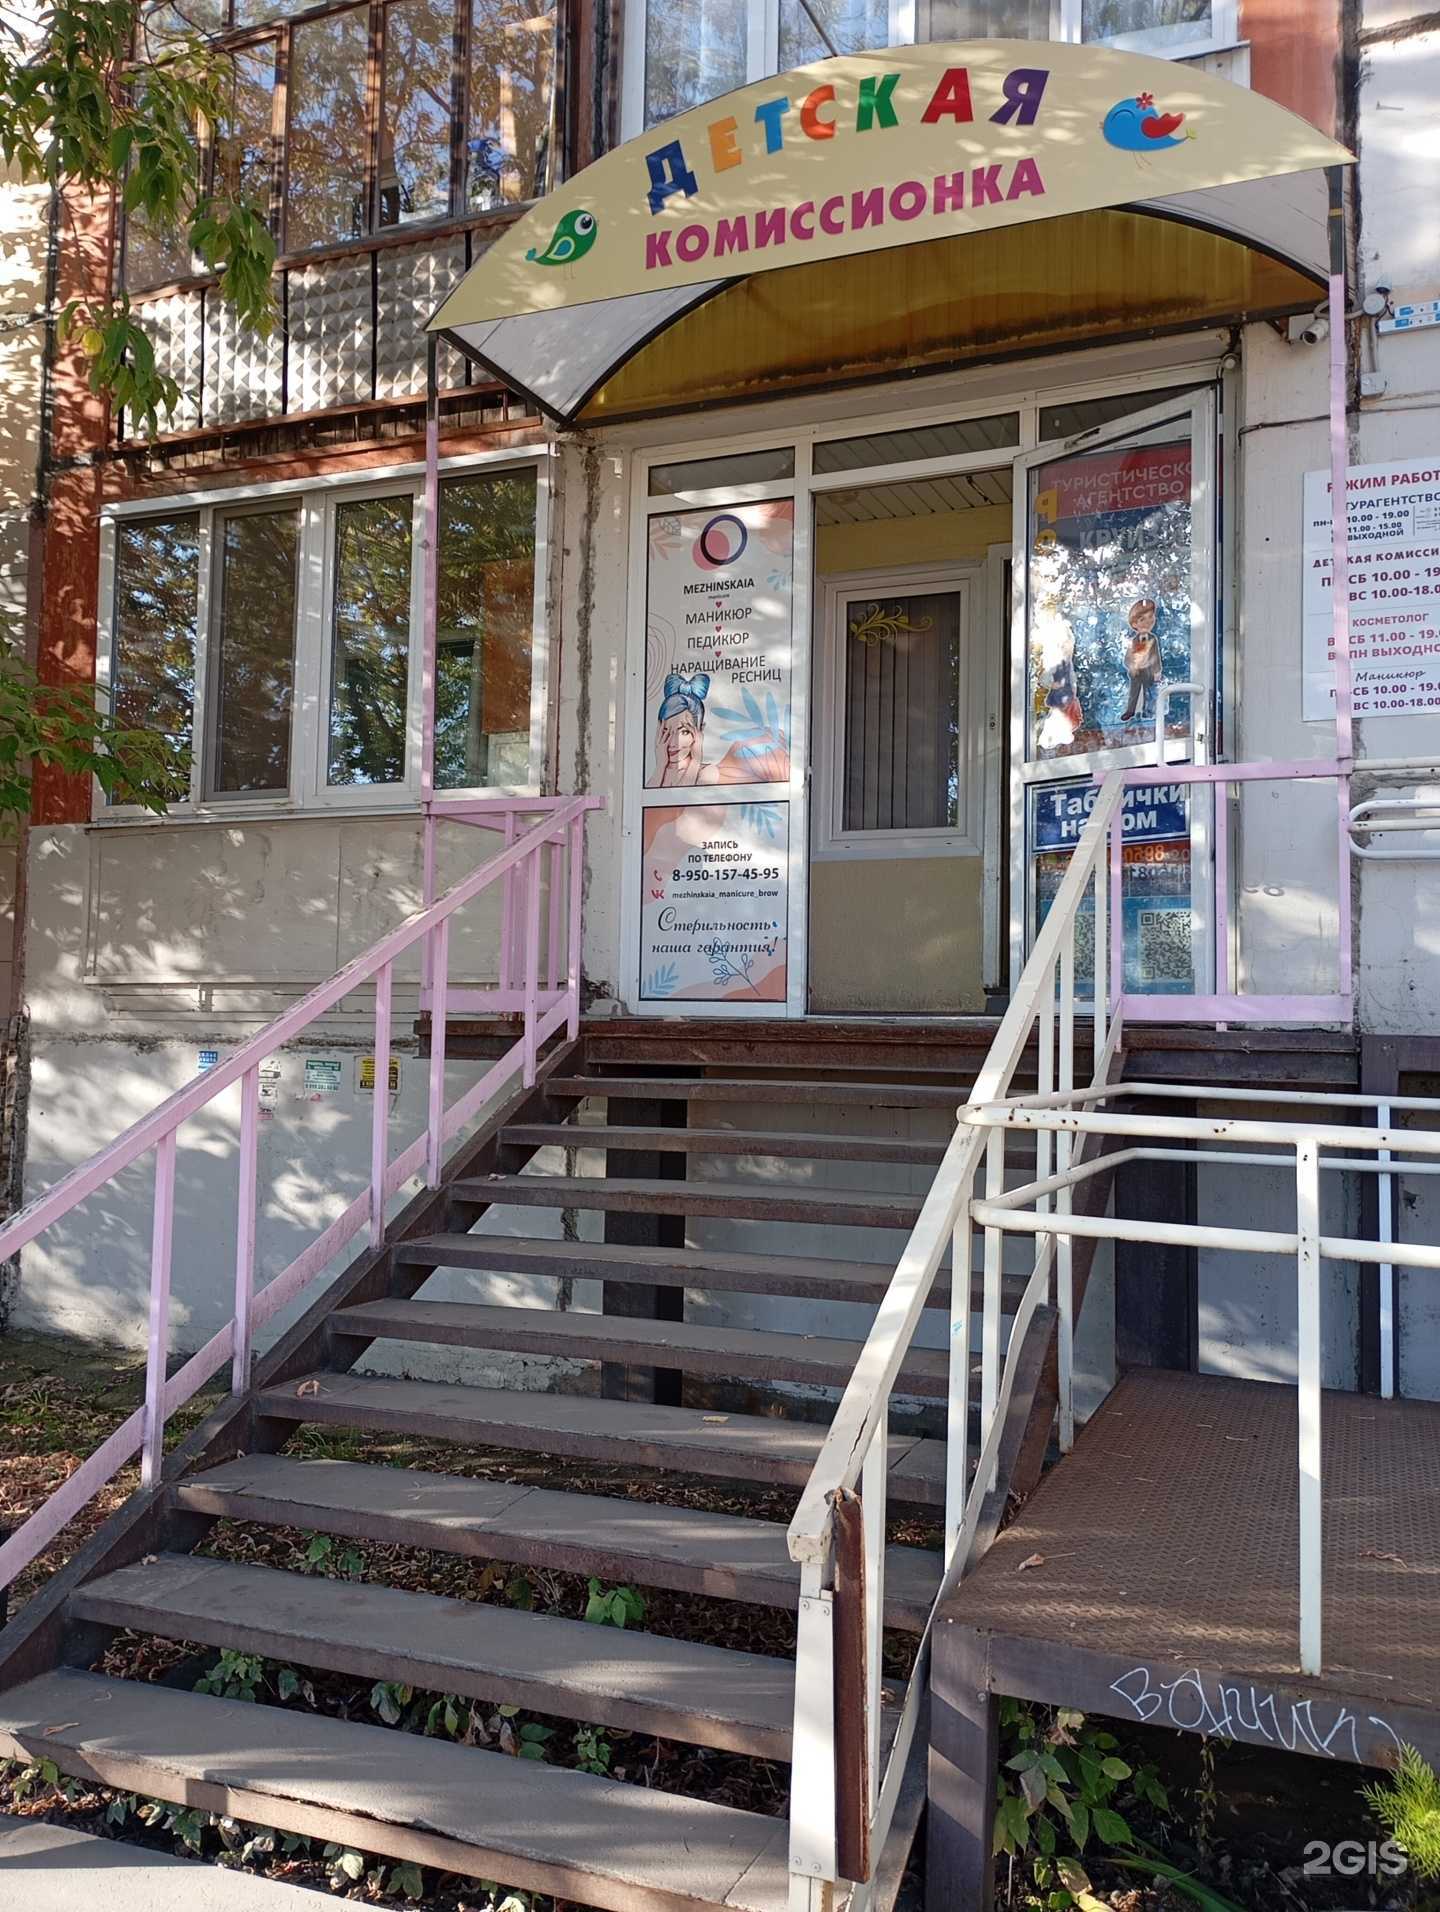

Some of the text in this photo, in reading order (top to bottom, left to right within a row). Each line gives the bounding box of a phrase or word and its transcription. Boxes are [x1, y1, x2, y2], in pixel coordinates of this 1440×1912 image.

[645, 67, 1050, 216] ДЕТСКАЯ
[645, 157, 1046, 270] КОМИССИОНКА
[1327, 476, 1386, 493] РЖИМ
[1076, 481, 1184, 507] АГЕНТСТВО
[1347, 514, 1373, 524] 10.00
[1383, 510, 1410, 520] 19.00
[1347, 529, 1404, 541] ВЫХОДНОЙ
[1348, 526, 1371, 534] 11.00
[1380, 522, 1403, 531] 15.00
[1372, 569, 1411, 583] 10.00
[684, 578, 755, 595] MEZHINSKAIA
[1349, 591, 1367, 601] ВС
[685, 607, 752, 624] МАНИКЮР
[1352, 613, 1430, 627] КОСМЕТОЛОГ
[687, 632, 750, 650] ПЕДИКЮР
[1370, 631, 1406, 643] 11.00
[671, 656, 766, 675] НАРАЩИВАНИЕ
[731, 669, 782, 684] РЕСНИЦ
[1355, 670, 1426, 682] Маникюр
[1373, 684, 1407, 695] 10.00
[1354, 702, 1369, 710] ВС
[1050, 784, 1186, 817] Табички
[702, 841, 738, 849] ЗАПИСЬ
[688, 853, 752, 863] ПО ТЕЛЕФОНУ
[672, 868, 779, 881] 8-950-157-45-95
[672, 889, 779, 900] mezhinskaia_manicure_brow
[658, 906, 771, 934] Стерильность
[652, 944, 691, 953] наша
